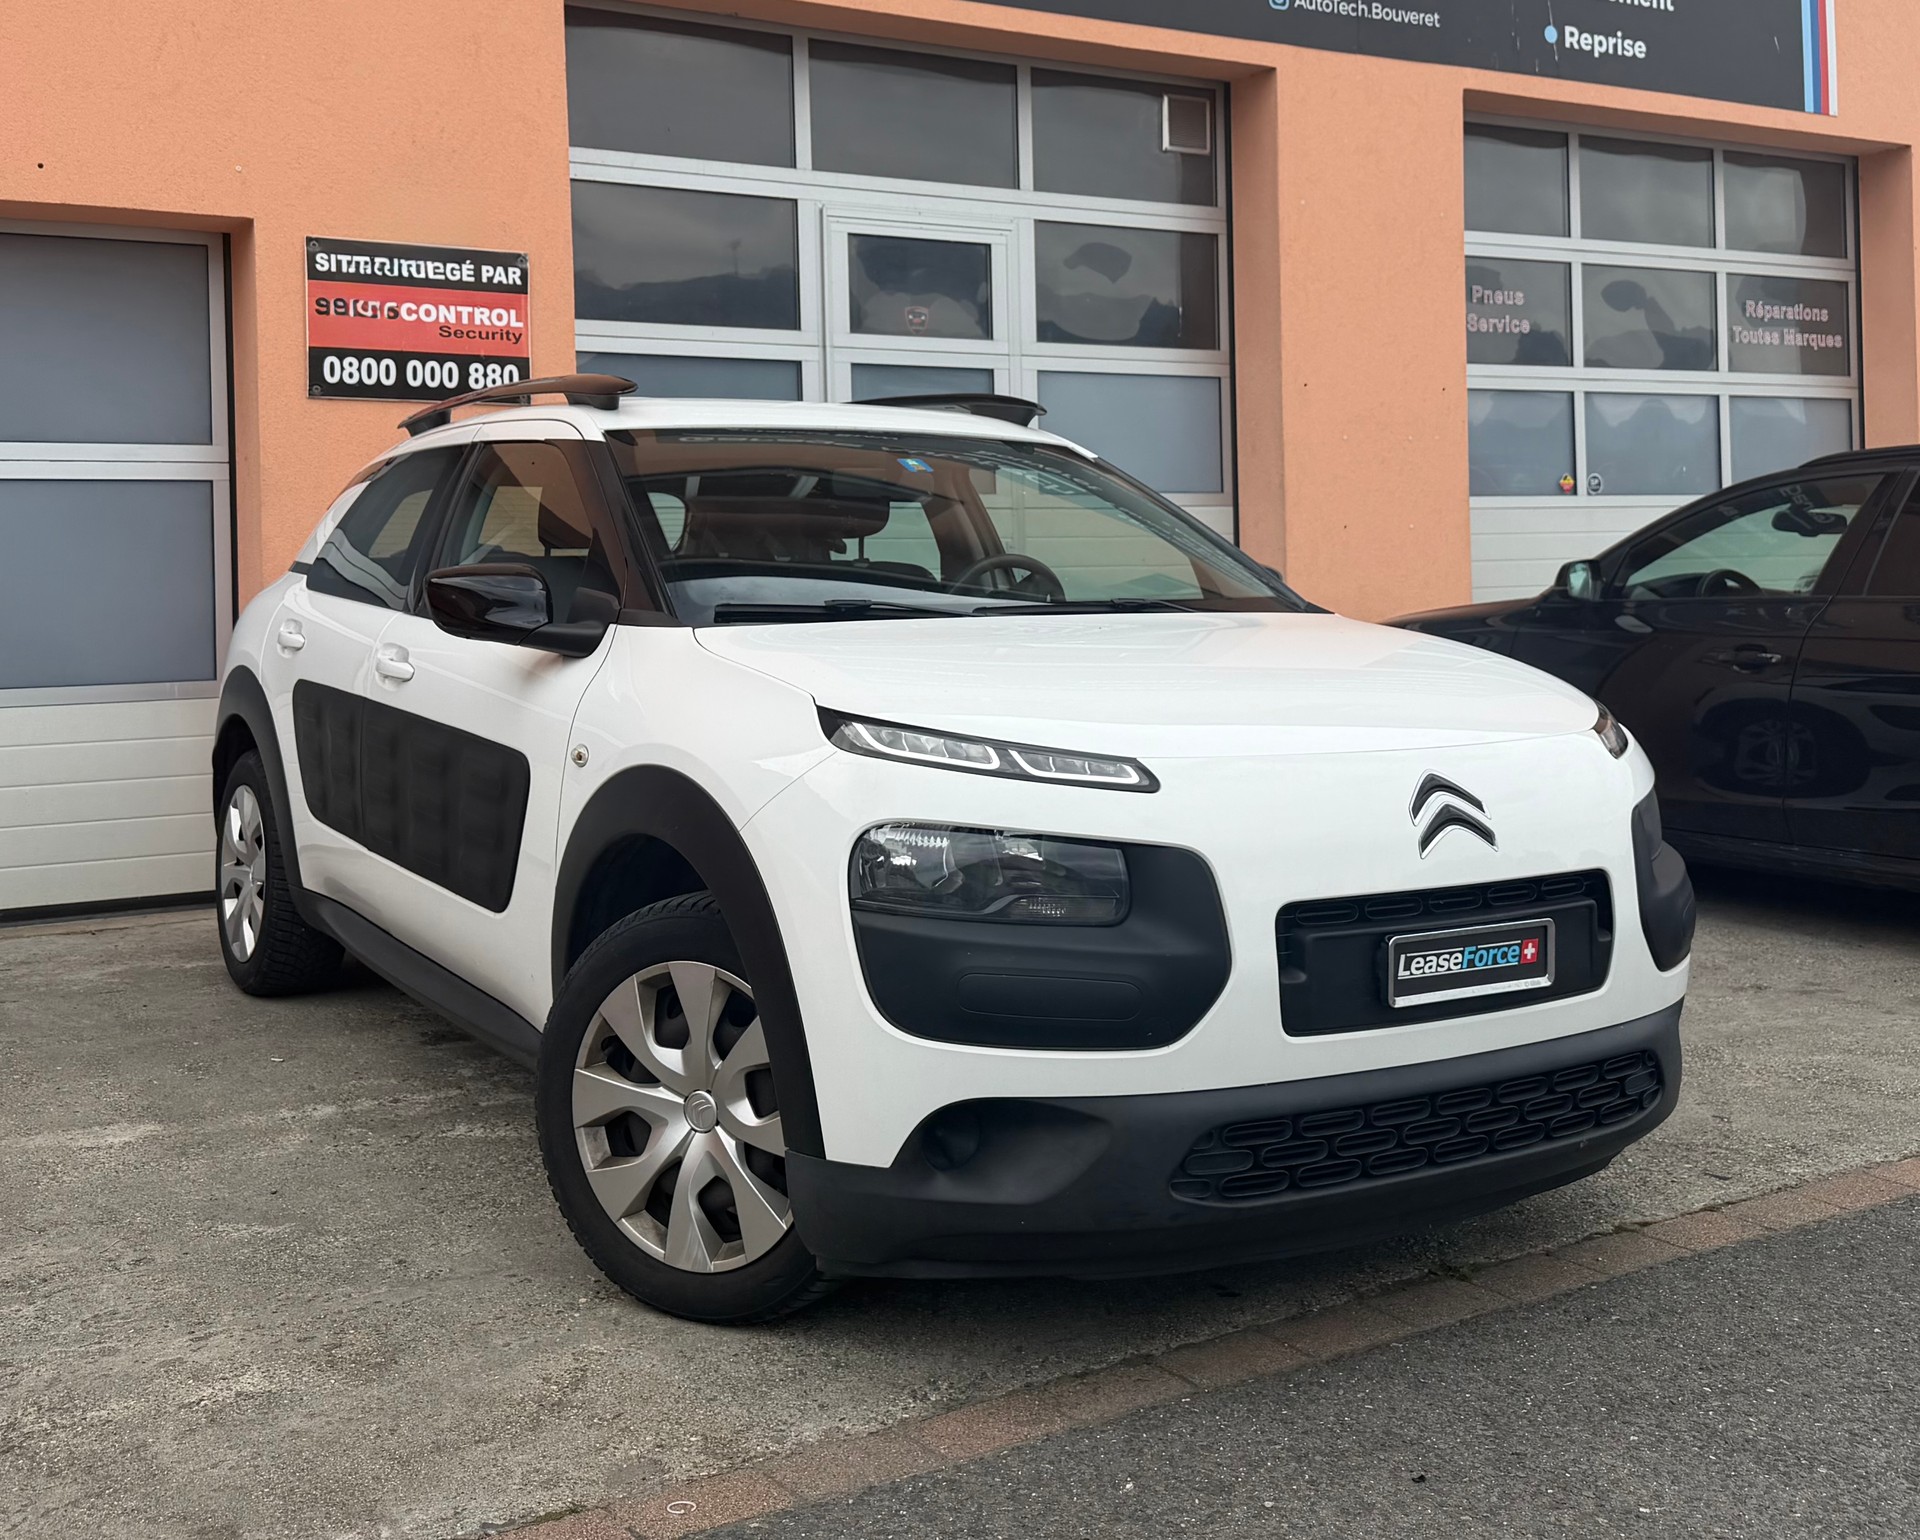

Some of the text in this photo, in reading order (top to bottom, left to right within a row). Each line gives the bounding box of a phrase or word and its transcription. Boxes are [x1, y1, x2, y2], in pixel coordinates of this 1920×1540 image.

[1564, 25, 1647, 59] Reprise
[481, 264, 522, 285] PAR
[1471, 284, 1525, 306] Pneus
[1745, 299, 1829, 322] Réparations
[1466, 312, 1531, 334] Service
[438, 325, 523, 345] Security
[1732, 325, 1843, 351] Toutes Marques
[323, 355, 520, 390] 0800 000 880
[1397, 944, 1520, 977] LeaseForce
